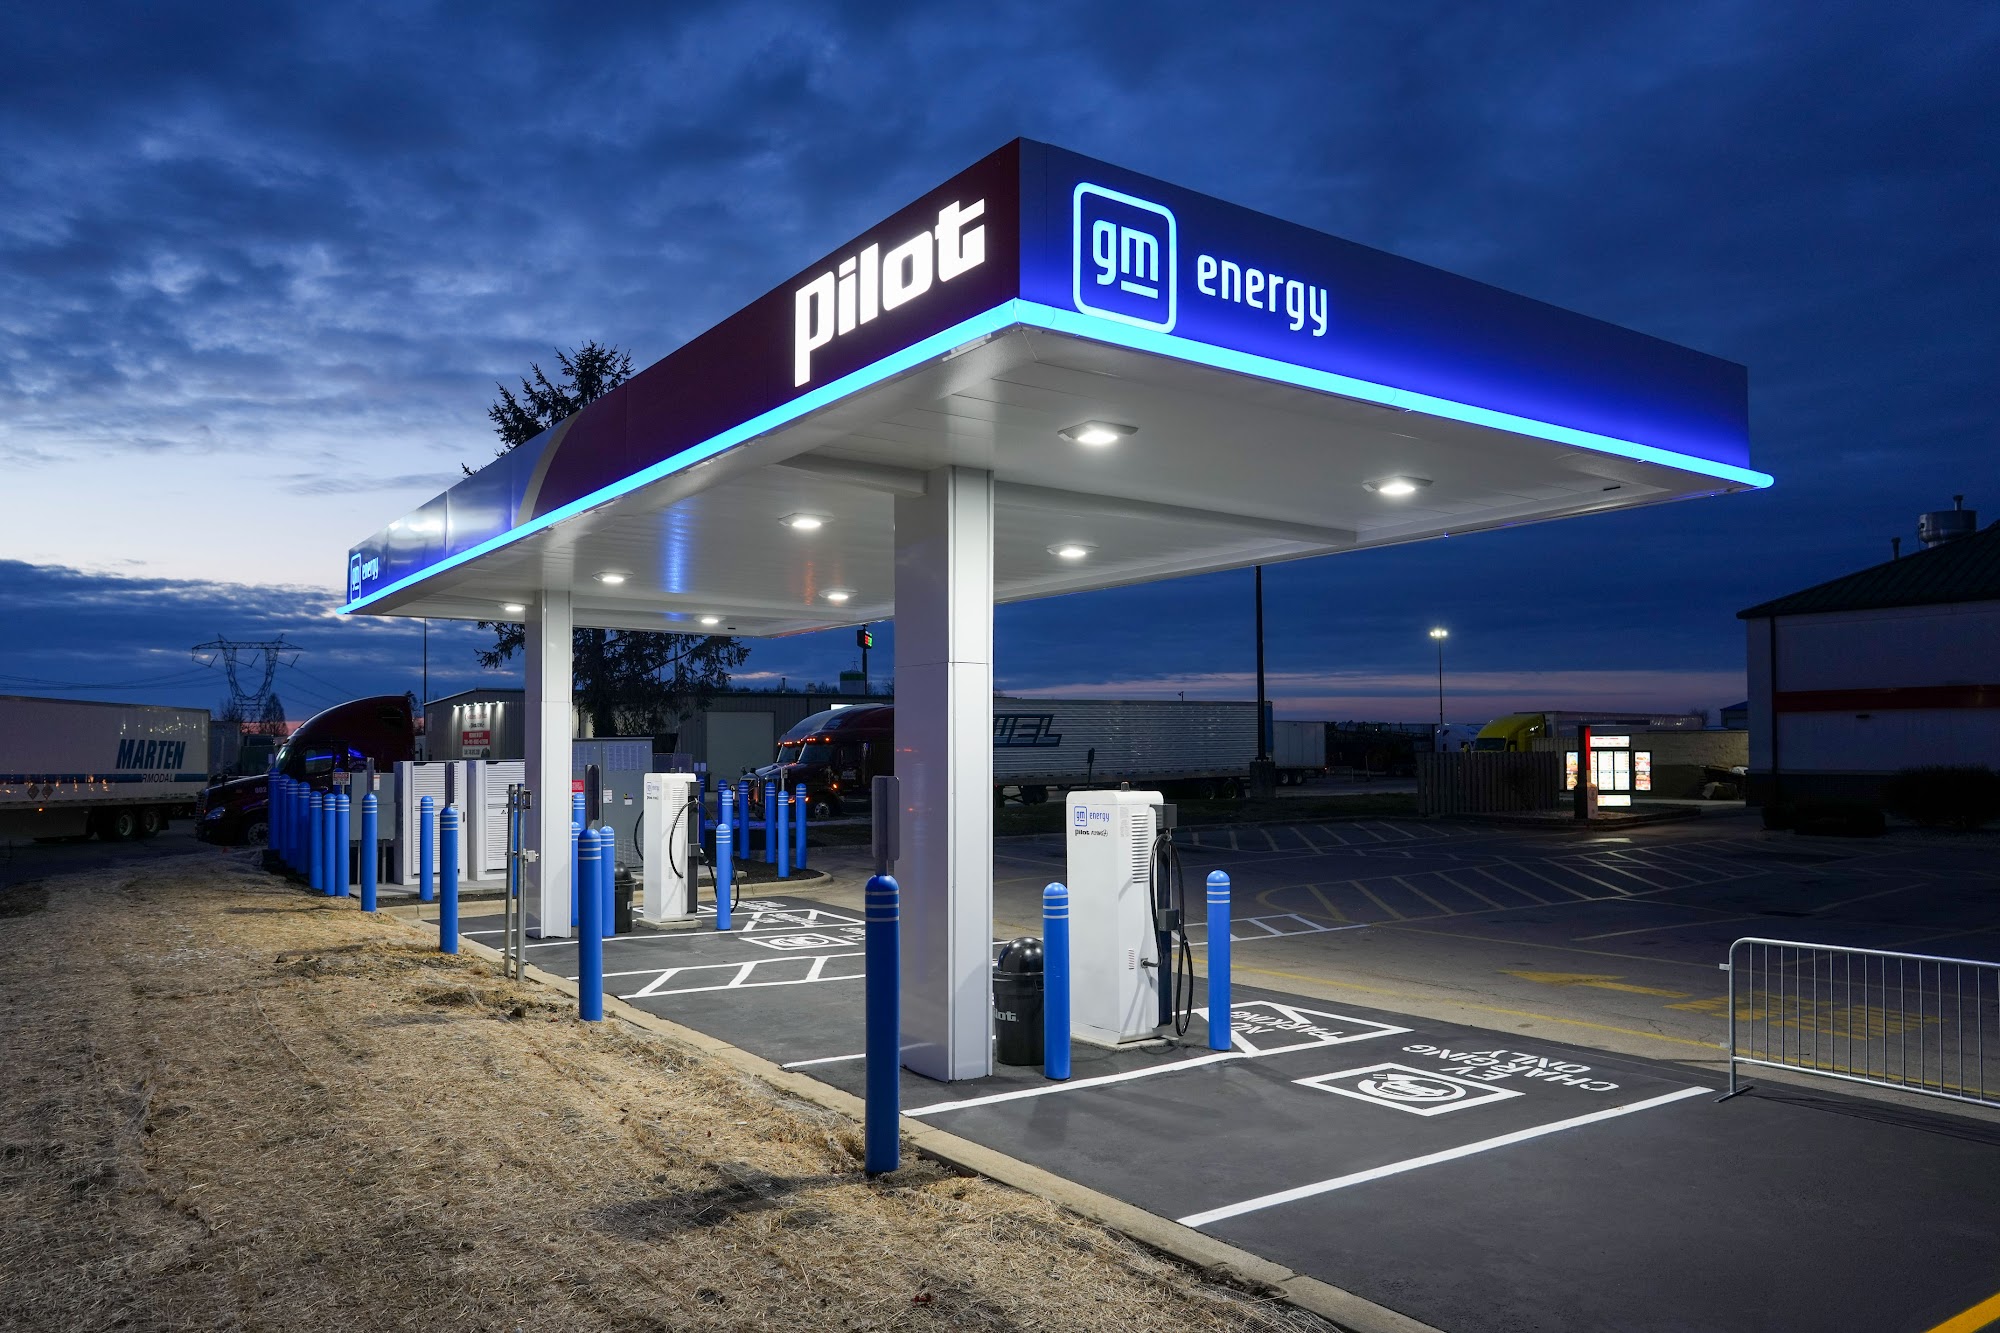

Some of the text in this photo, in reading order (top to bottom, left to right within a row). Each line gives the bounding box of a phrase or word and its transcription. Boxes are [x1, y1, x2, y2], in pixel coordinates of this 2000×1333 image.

[794, 198, 985, 388] pilot
[1197, 253, 1328, 337] energy
[115, 739, 186, 769] MARTEN
[1089, 812, 1110, 823] energy
[1402, 1044, 1620, 1091] CHARGING
[1440, 1066, 1512, 1081] EV
[1471, 1050, 1591, 1074] ONLY
